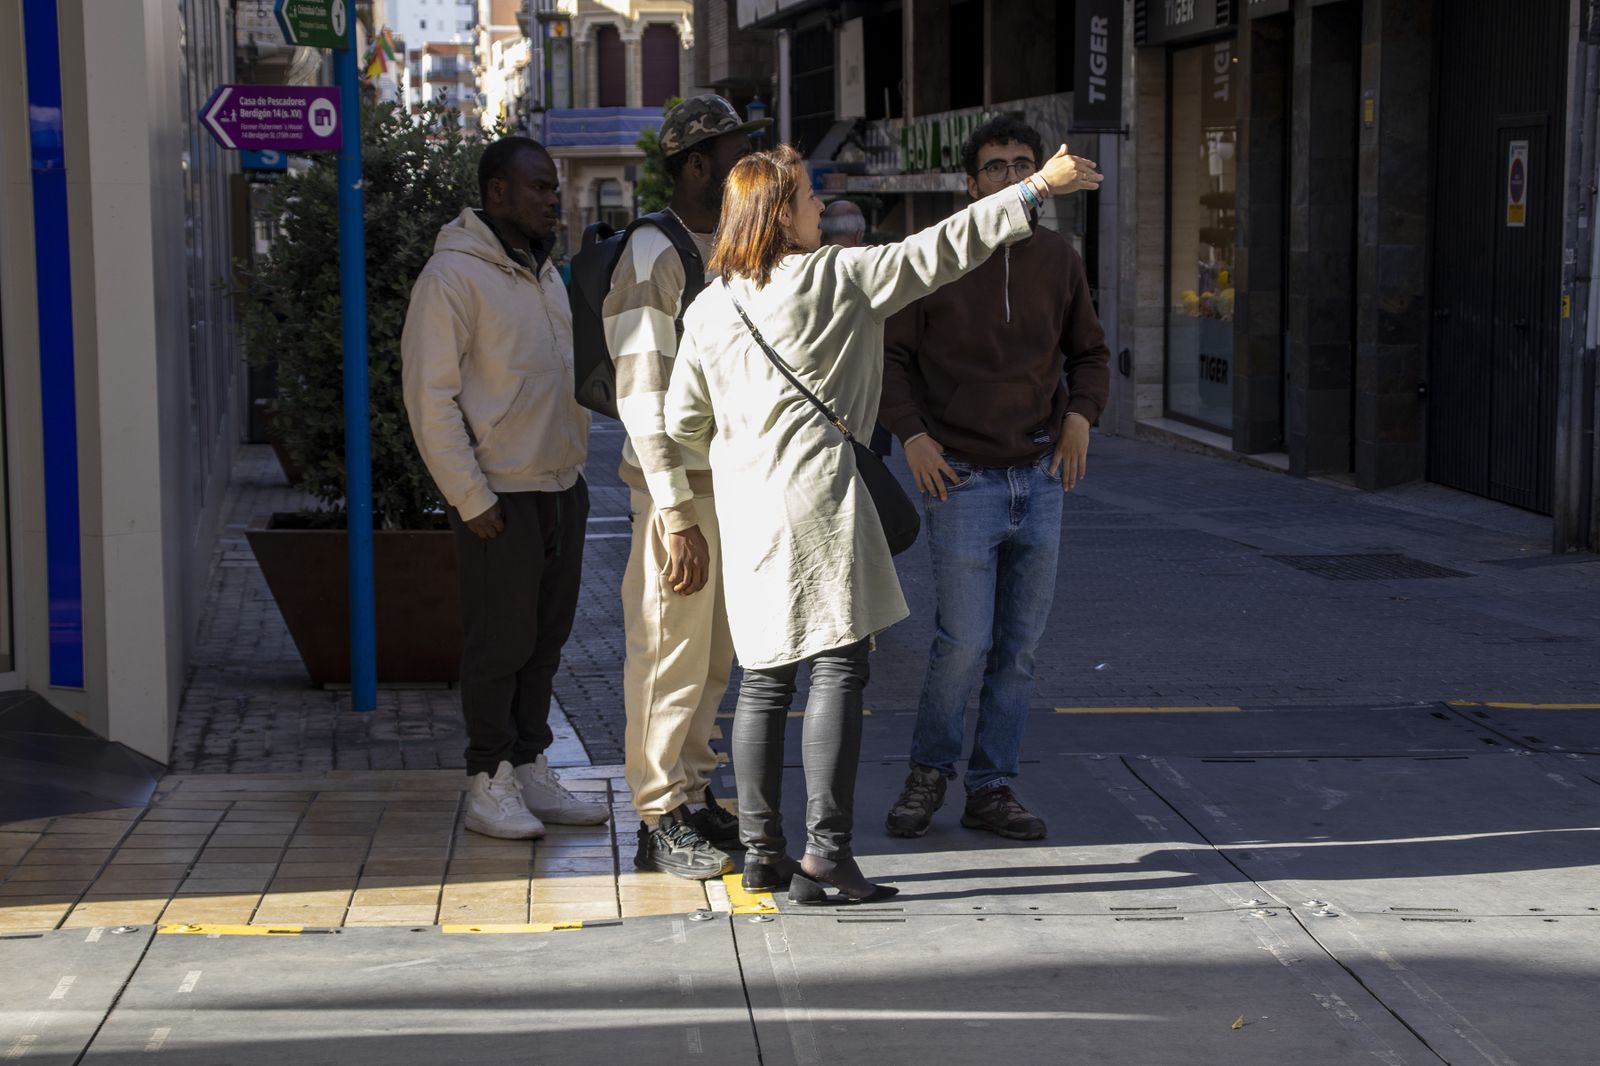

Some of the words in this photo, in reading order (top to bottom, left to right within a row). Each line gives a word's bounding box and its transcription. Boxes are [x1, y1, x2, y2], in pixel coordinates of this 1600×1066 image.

[1088, 15, 1108, 104] TIGER
[239, 96, 256, 106] Casa
[257, 96, 266, 106] de
[267, 96, 306, 107] Pescadores
[240, 108, 271, 120] Berdigón
[272, 109, 281, 118] 14
[290, 109, 303, 119] XV)
[1200, 354, 1228, 384] TIGER
